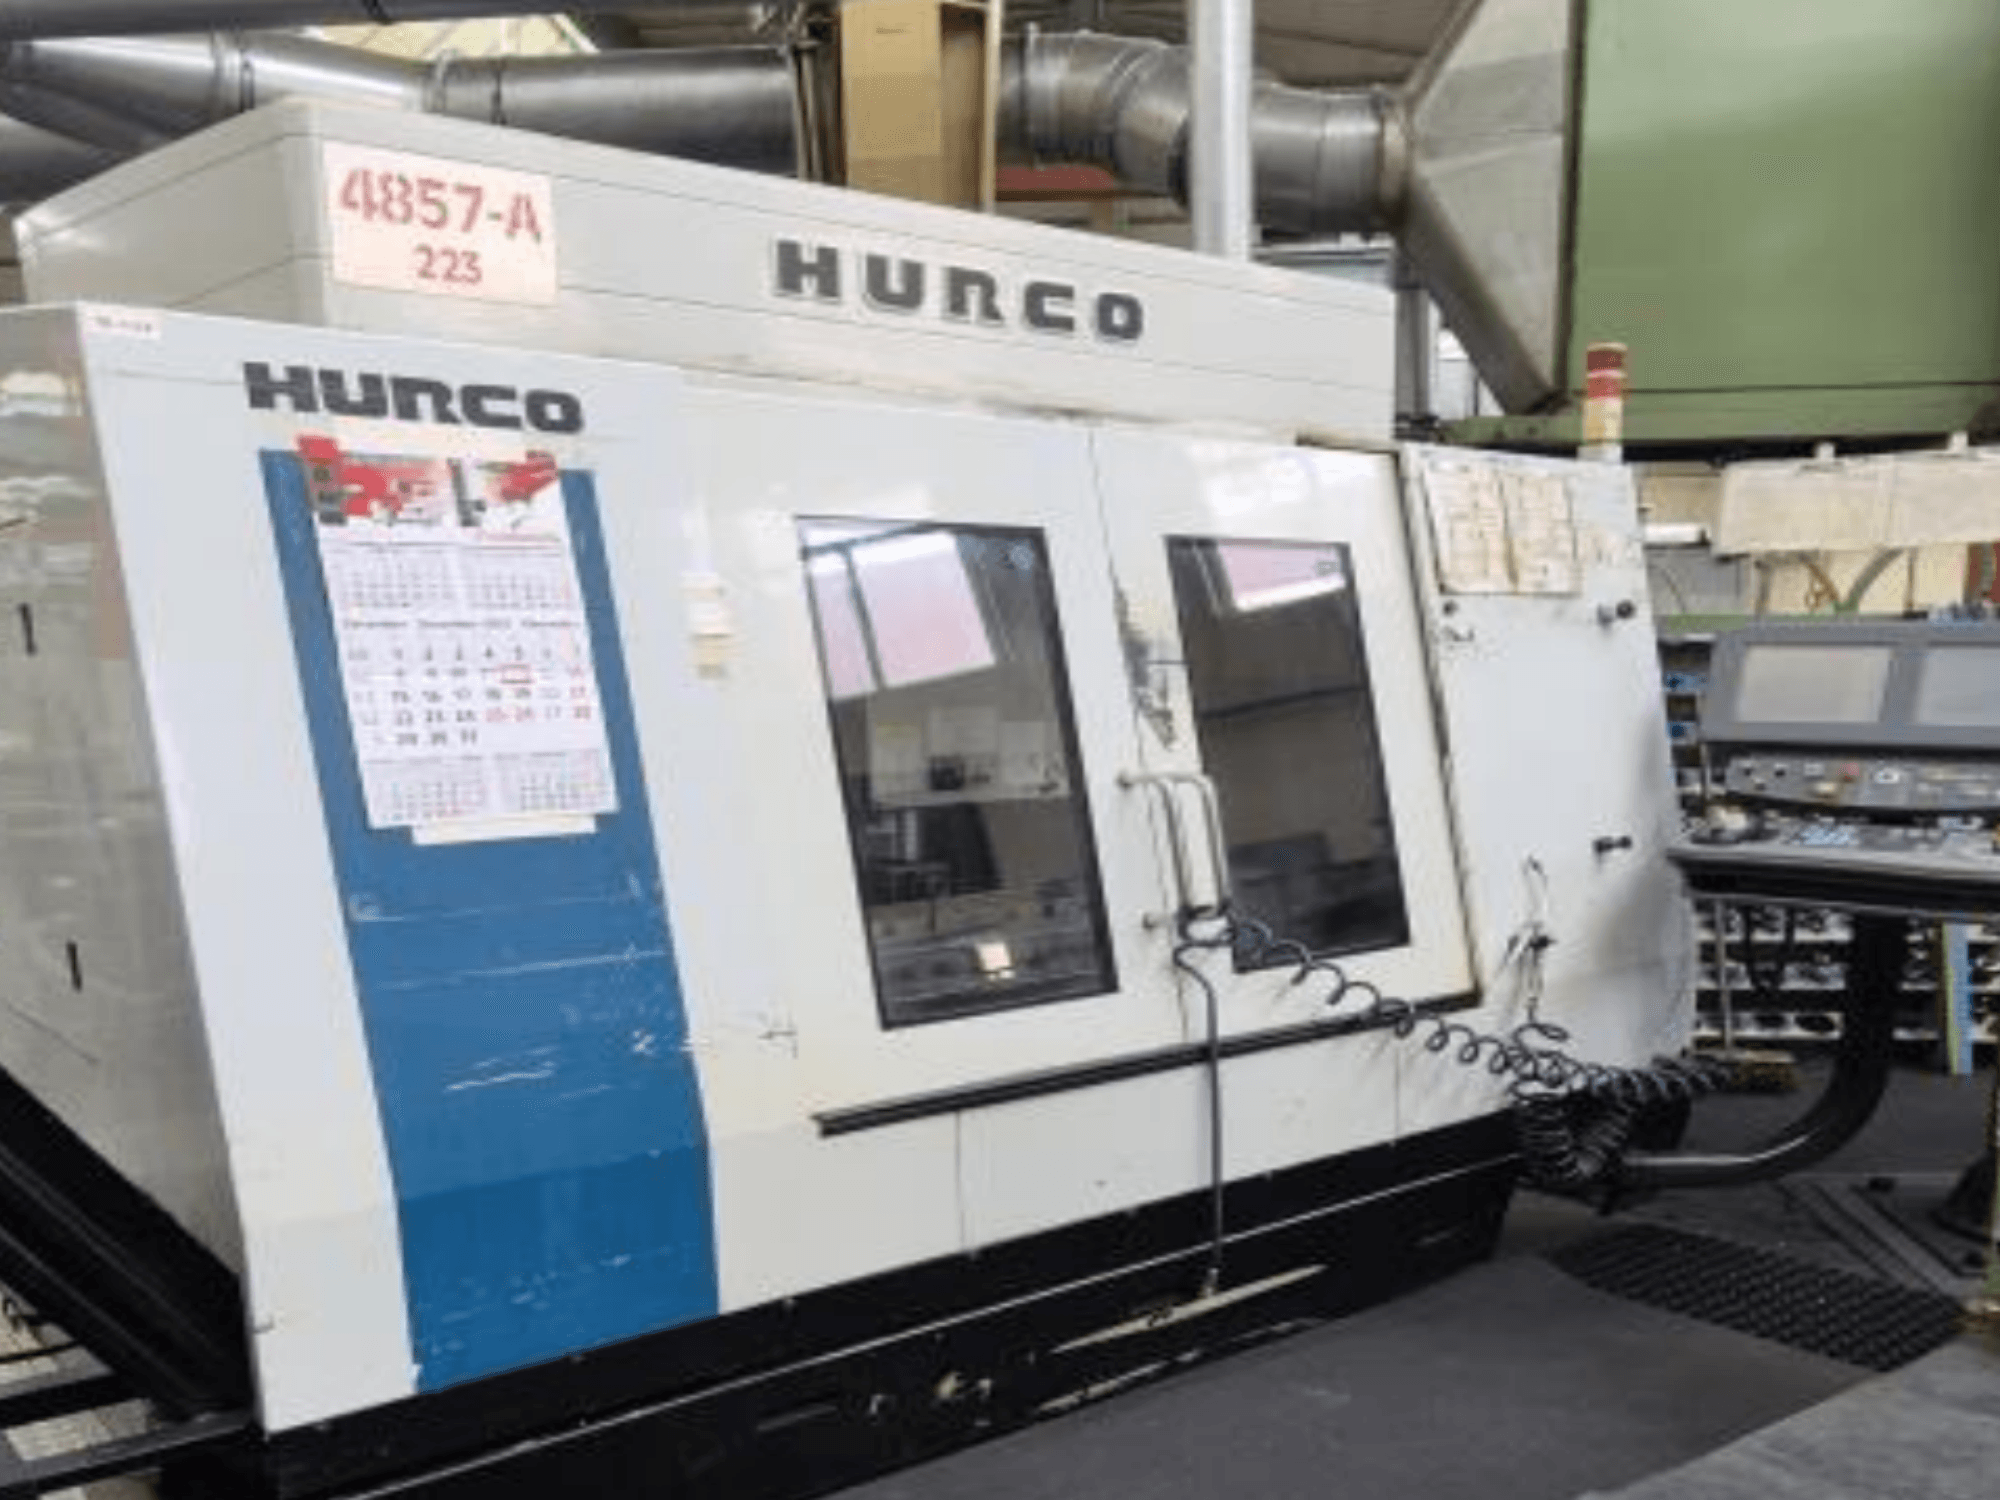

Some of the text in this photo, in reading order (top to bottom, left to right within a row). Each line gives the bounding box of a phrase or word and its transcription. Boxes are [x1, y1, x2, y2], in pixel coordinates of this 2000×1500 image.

[339, 167, 543, 244] 4857-A
[415, 244, 483, 286] 223
[776, 239, 1145, 344] HURCO
[243, 361, 584, 434] HURCO
